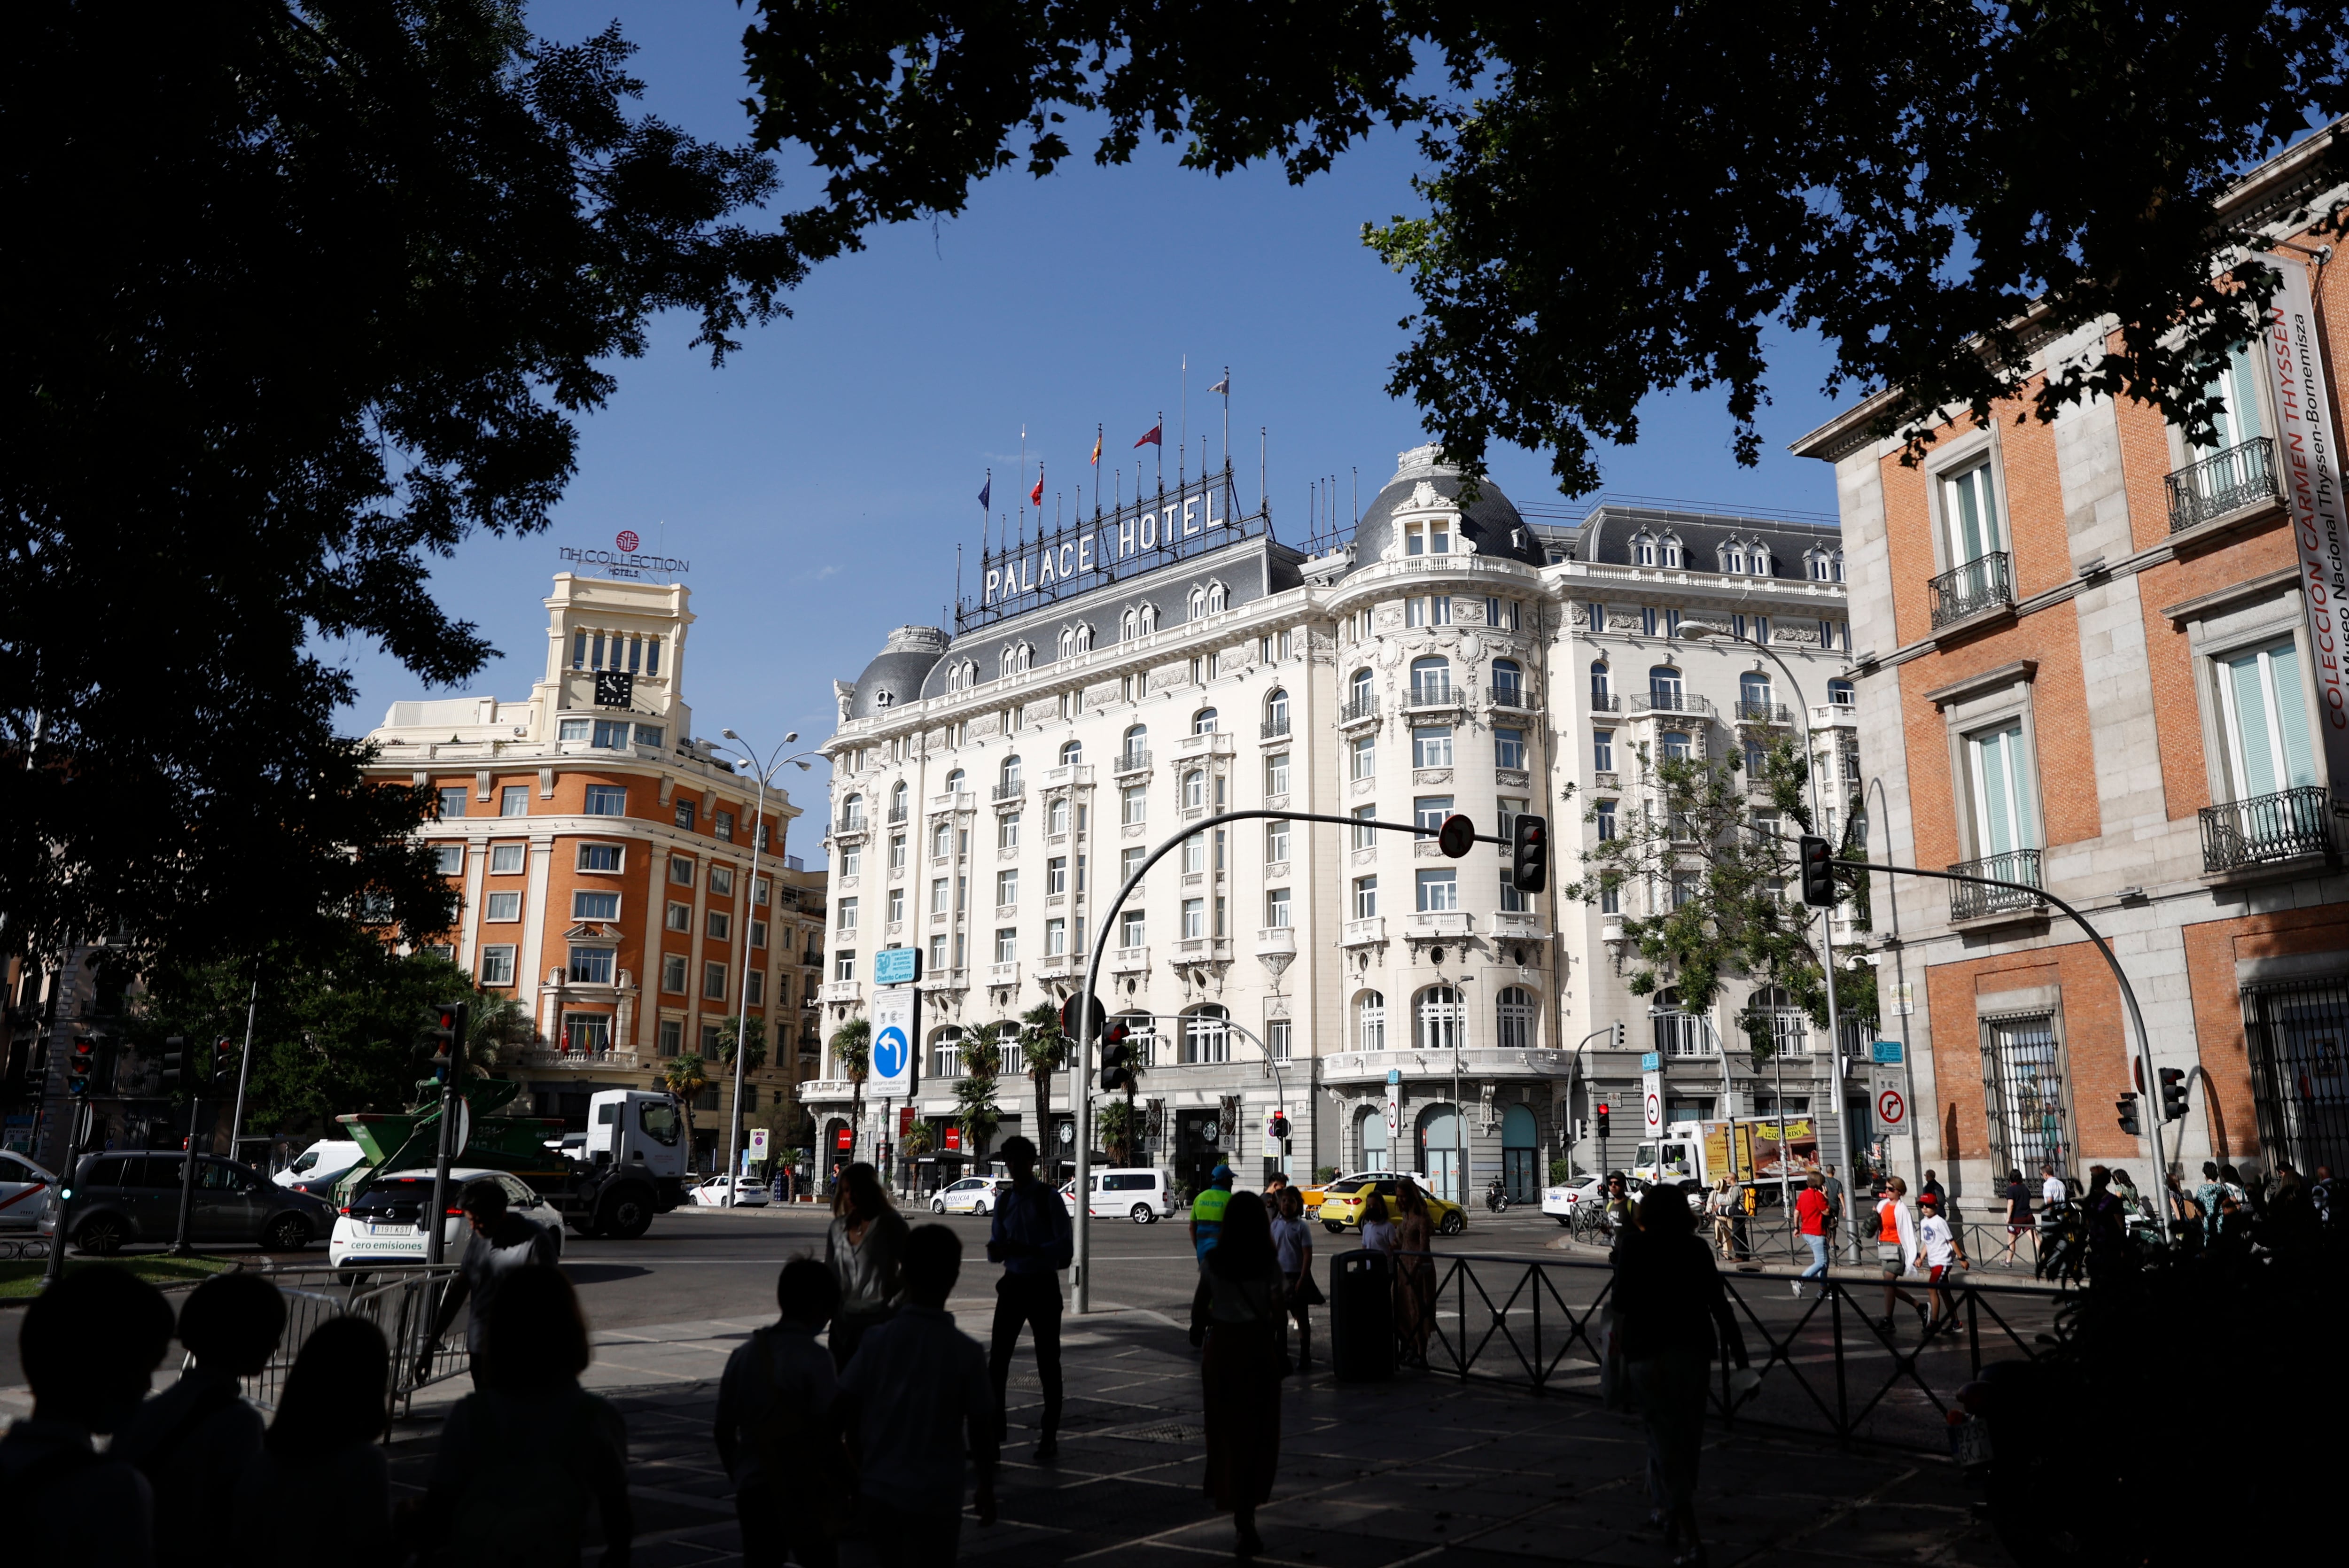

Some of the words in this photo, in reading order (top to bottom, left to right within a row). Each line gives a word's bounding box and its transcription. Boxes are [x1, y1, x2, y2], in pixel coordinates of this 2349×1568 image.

[2271, 307, 2300, 422] THYSSEN
[2295, 314, 2333, 508] Thyssen-Bornemisza
[987, 534, 1095, 604] PALACE
[1119, 491, 1223, 558] HOTEL
[2288, 432, 2318, 551] CARMEN
[585, 550, 689, 573] COLLECTION
[608, 567, 639, 577] HOTELS
[2320, 513, 2347, 600] Nacional
[2307, 561, 2346, 730] COLECCIÓN
[373, 1241, 422, 1250] emisiones
